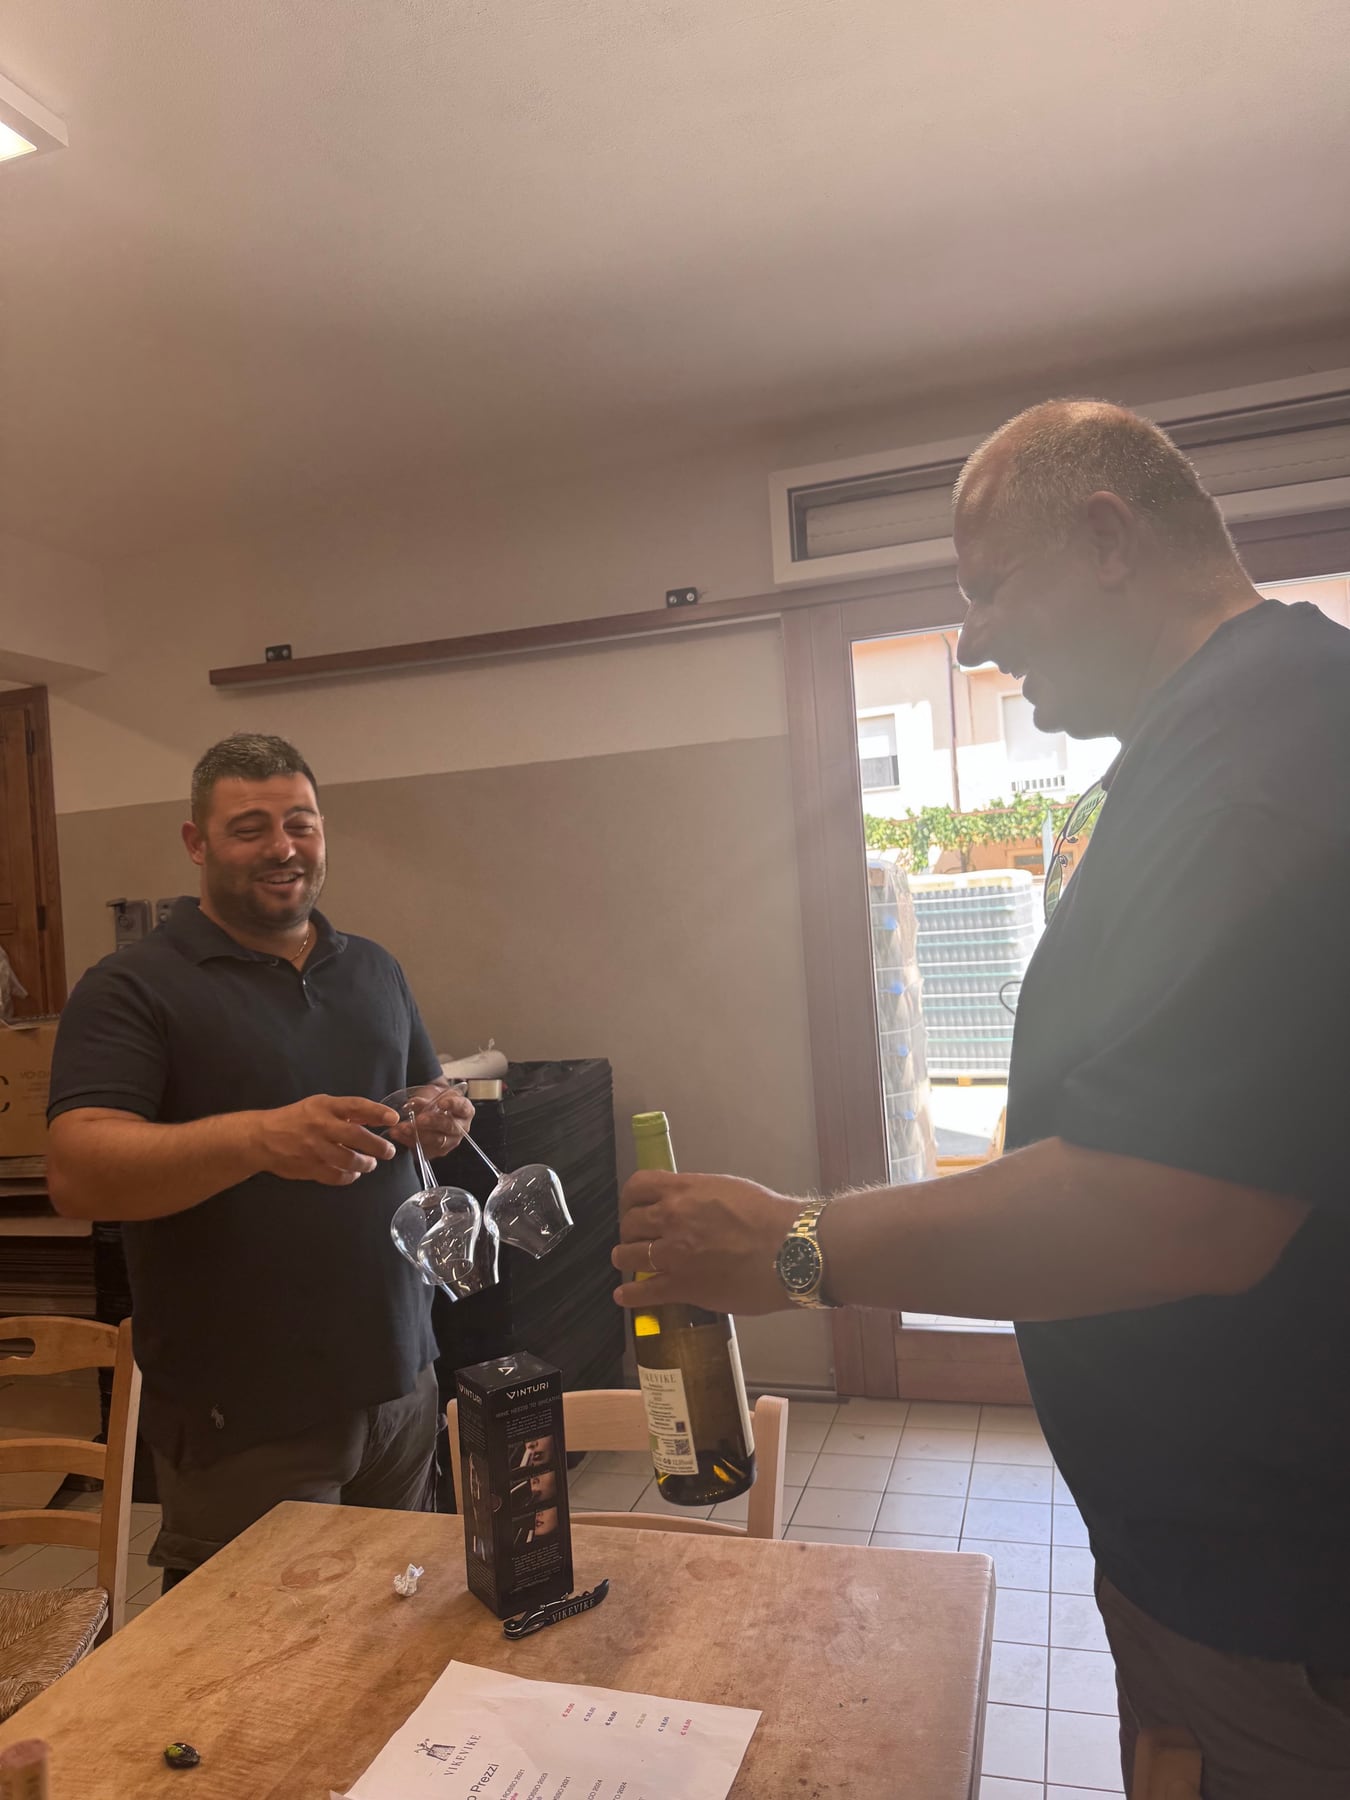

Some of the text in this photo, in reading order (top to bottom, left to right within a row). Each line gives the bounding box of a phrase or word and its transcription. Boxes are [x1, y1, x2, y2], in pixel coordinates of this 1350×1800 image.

[506, 1381, 549, 1400] VINTURI
[551, 1599, 595, 1622] VIKEVIKE
[444, 1734, 482, 1776] VIKEVIKE
[470, 1763, 500, 1793] Prezzi
